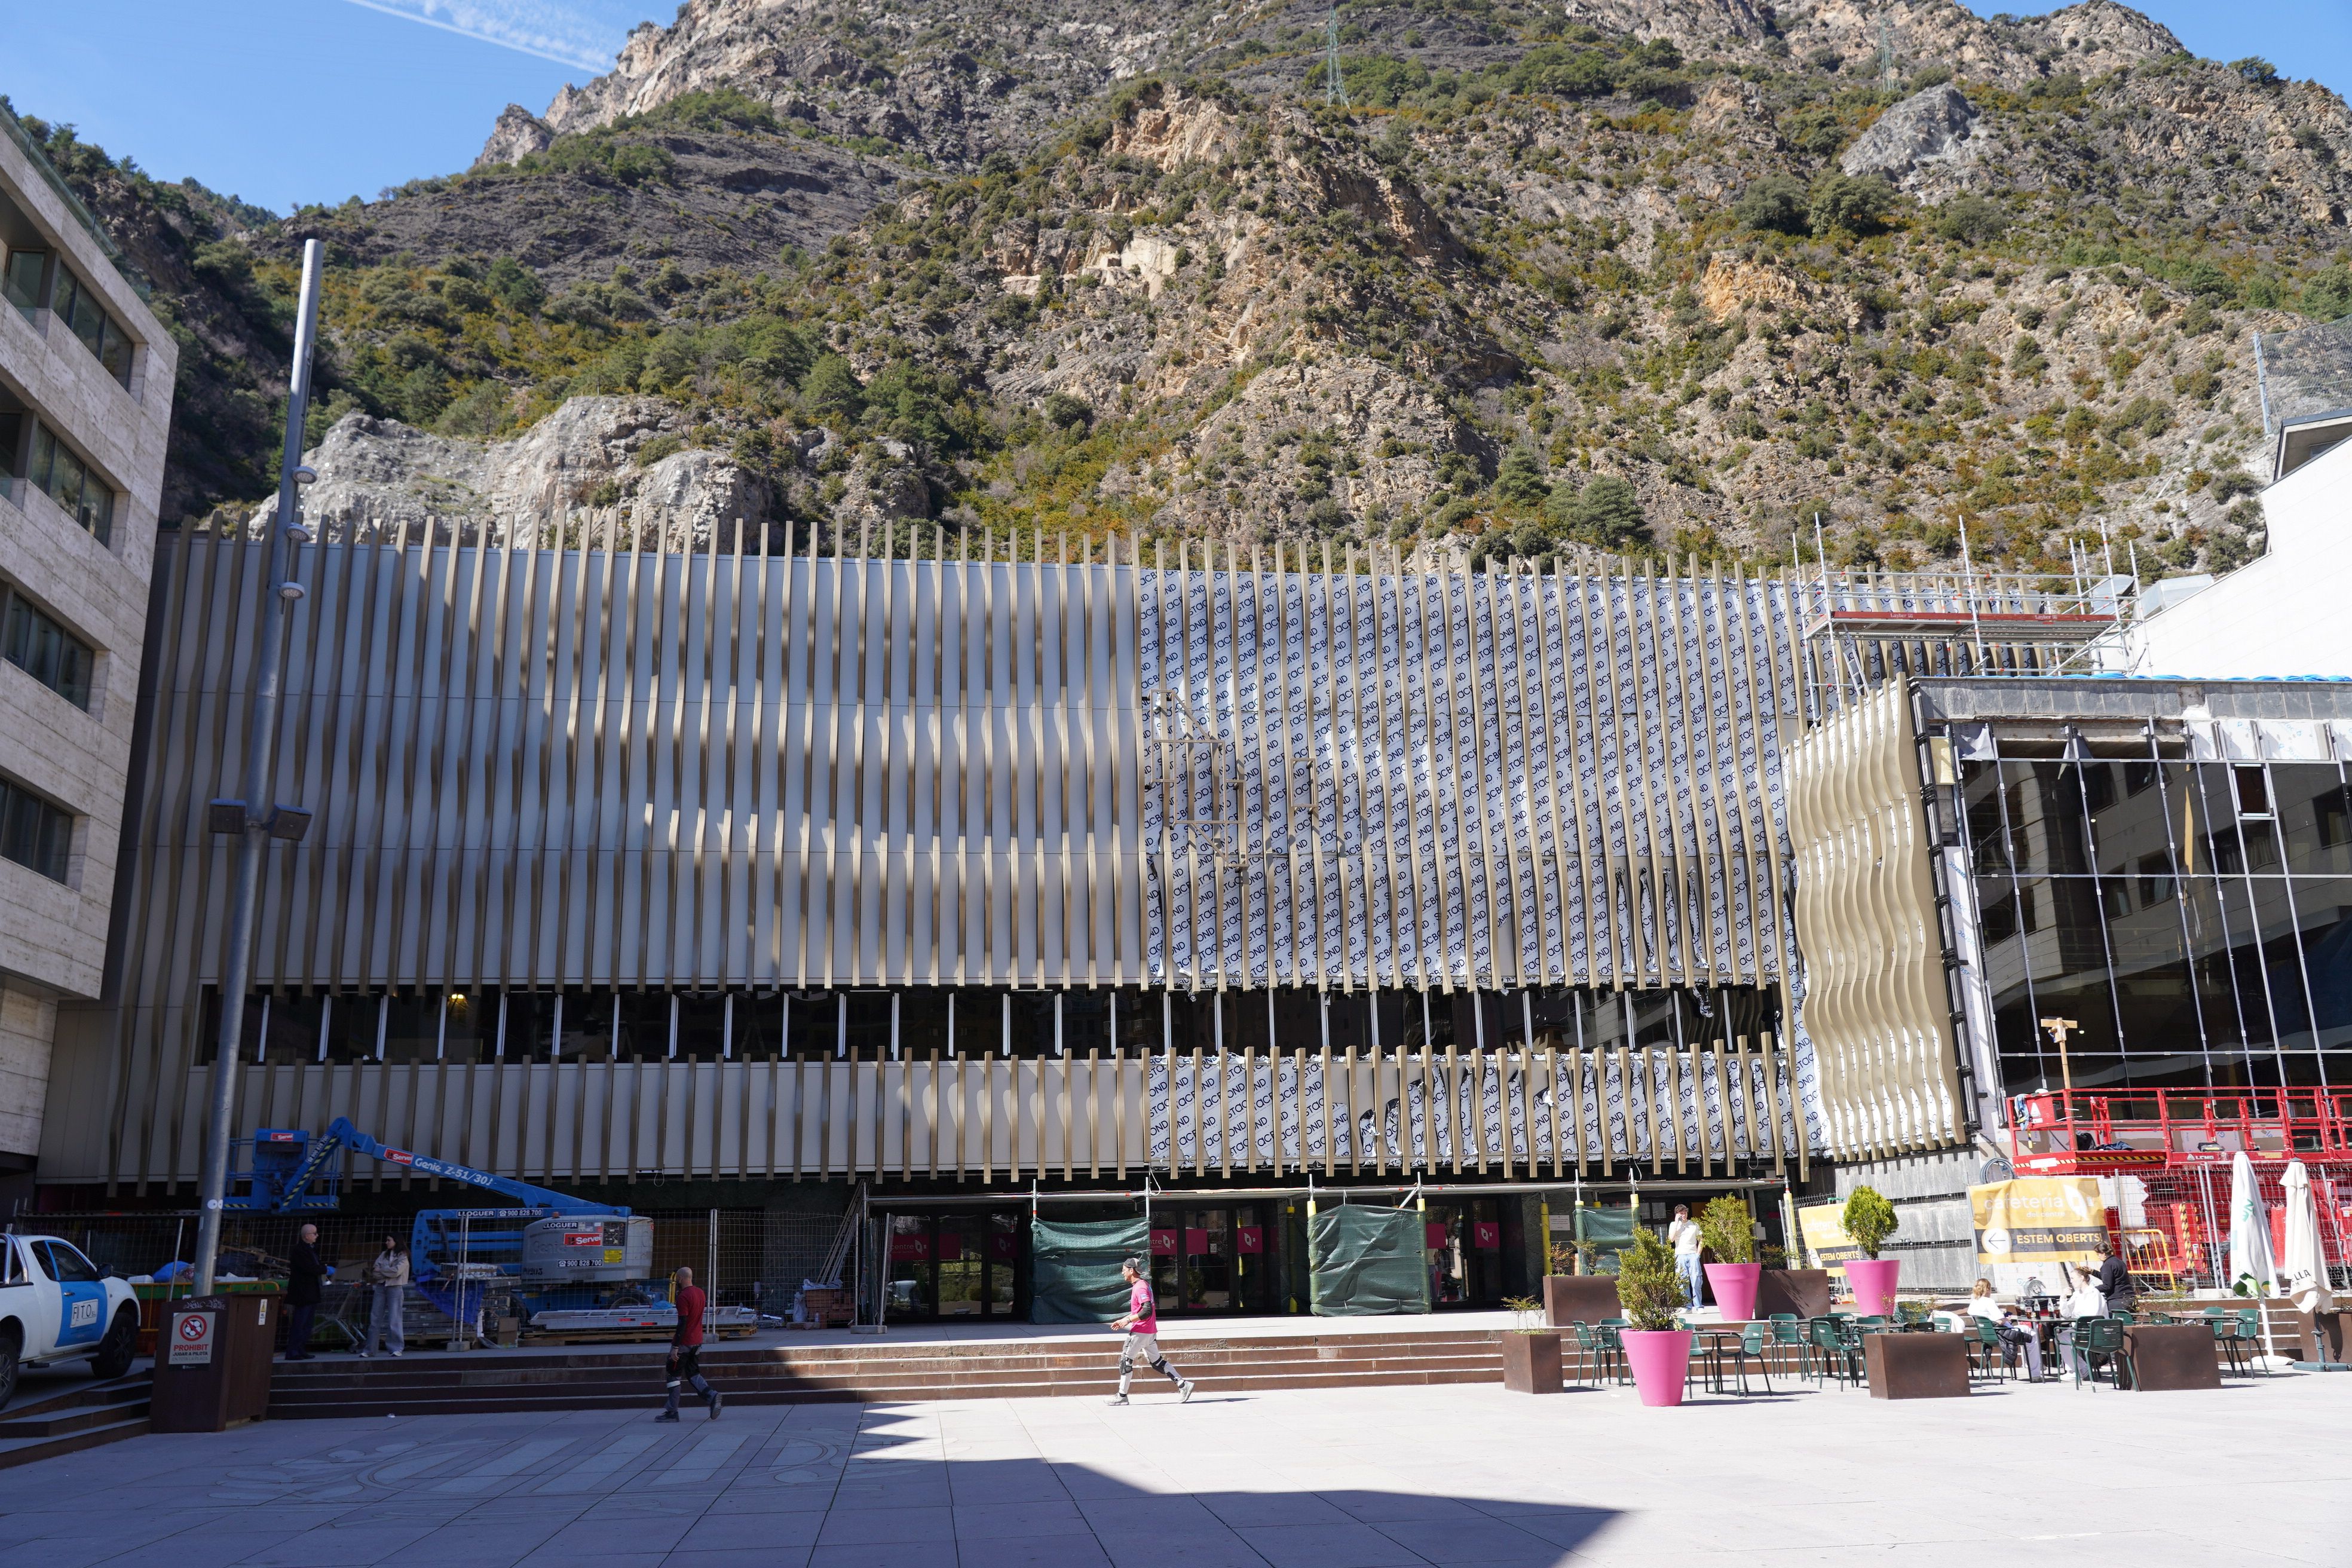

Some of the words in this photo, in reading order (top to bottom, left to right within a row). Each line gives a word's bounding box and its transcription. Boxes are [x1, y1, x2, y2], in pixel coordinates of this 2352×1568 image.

[415, 1158, 441, 1172] Genie
[1984, 1193, 2063, 1209] cafeteria
[576, 1235, 601, 1244] Servei
[2016, 1235, 2053, 1244] ESTEM
[2056, 1233, 2102, 1243] OBERTS!
[1820, 1252, 1836, 1261] ESTEM
[1836, 1251, 1863, 1260] OBERTS!
